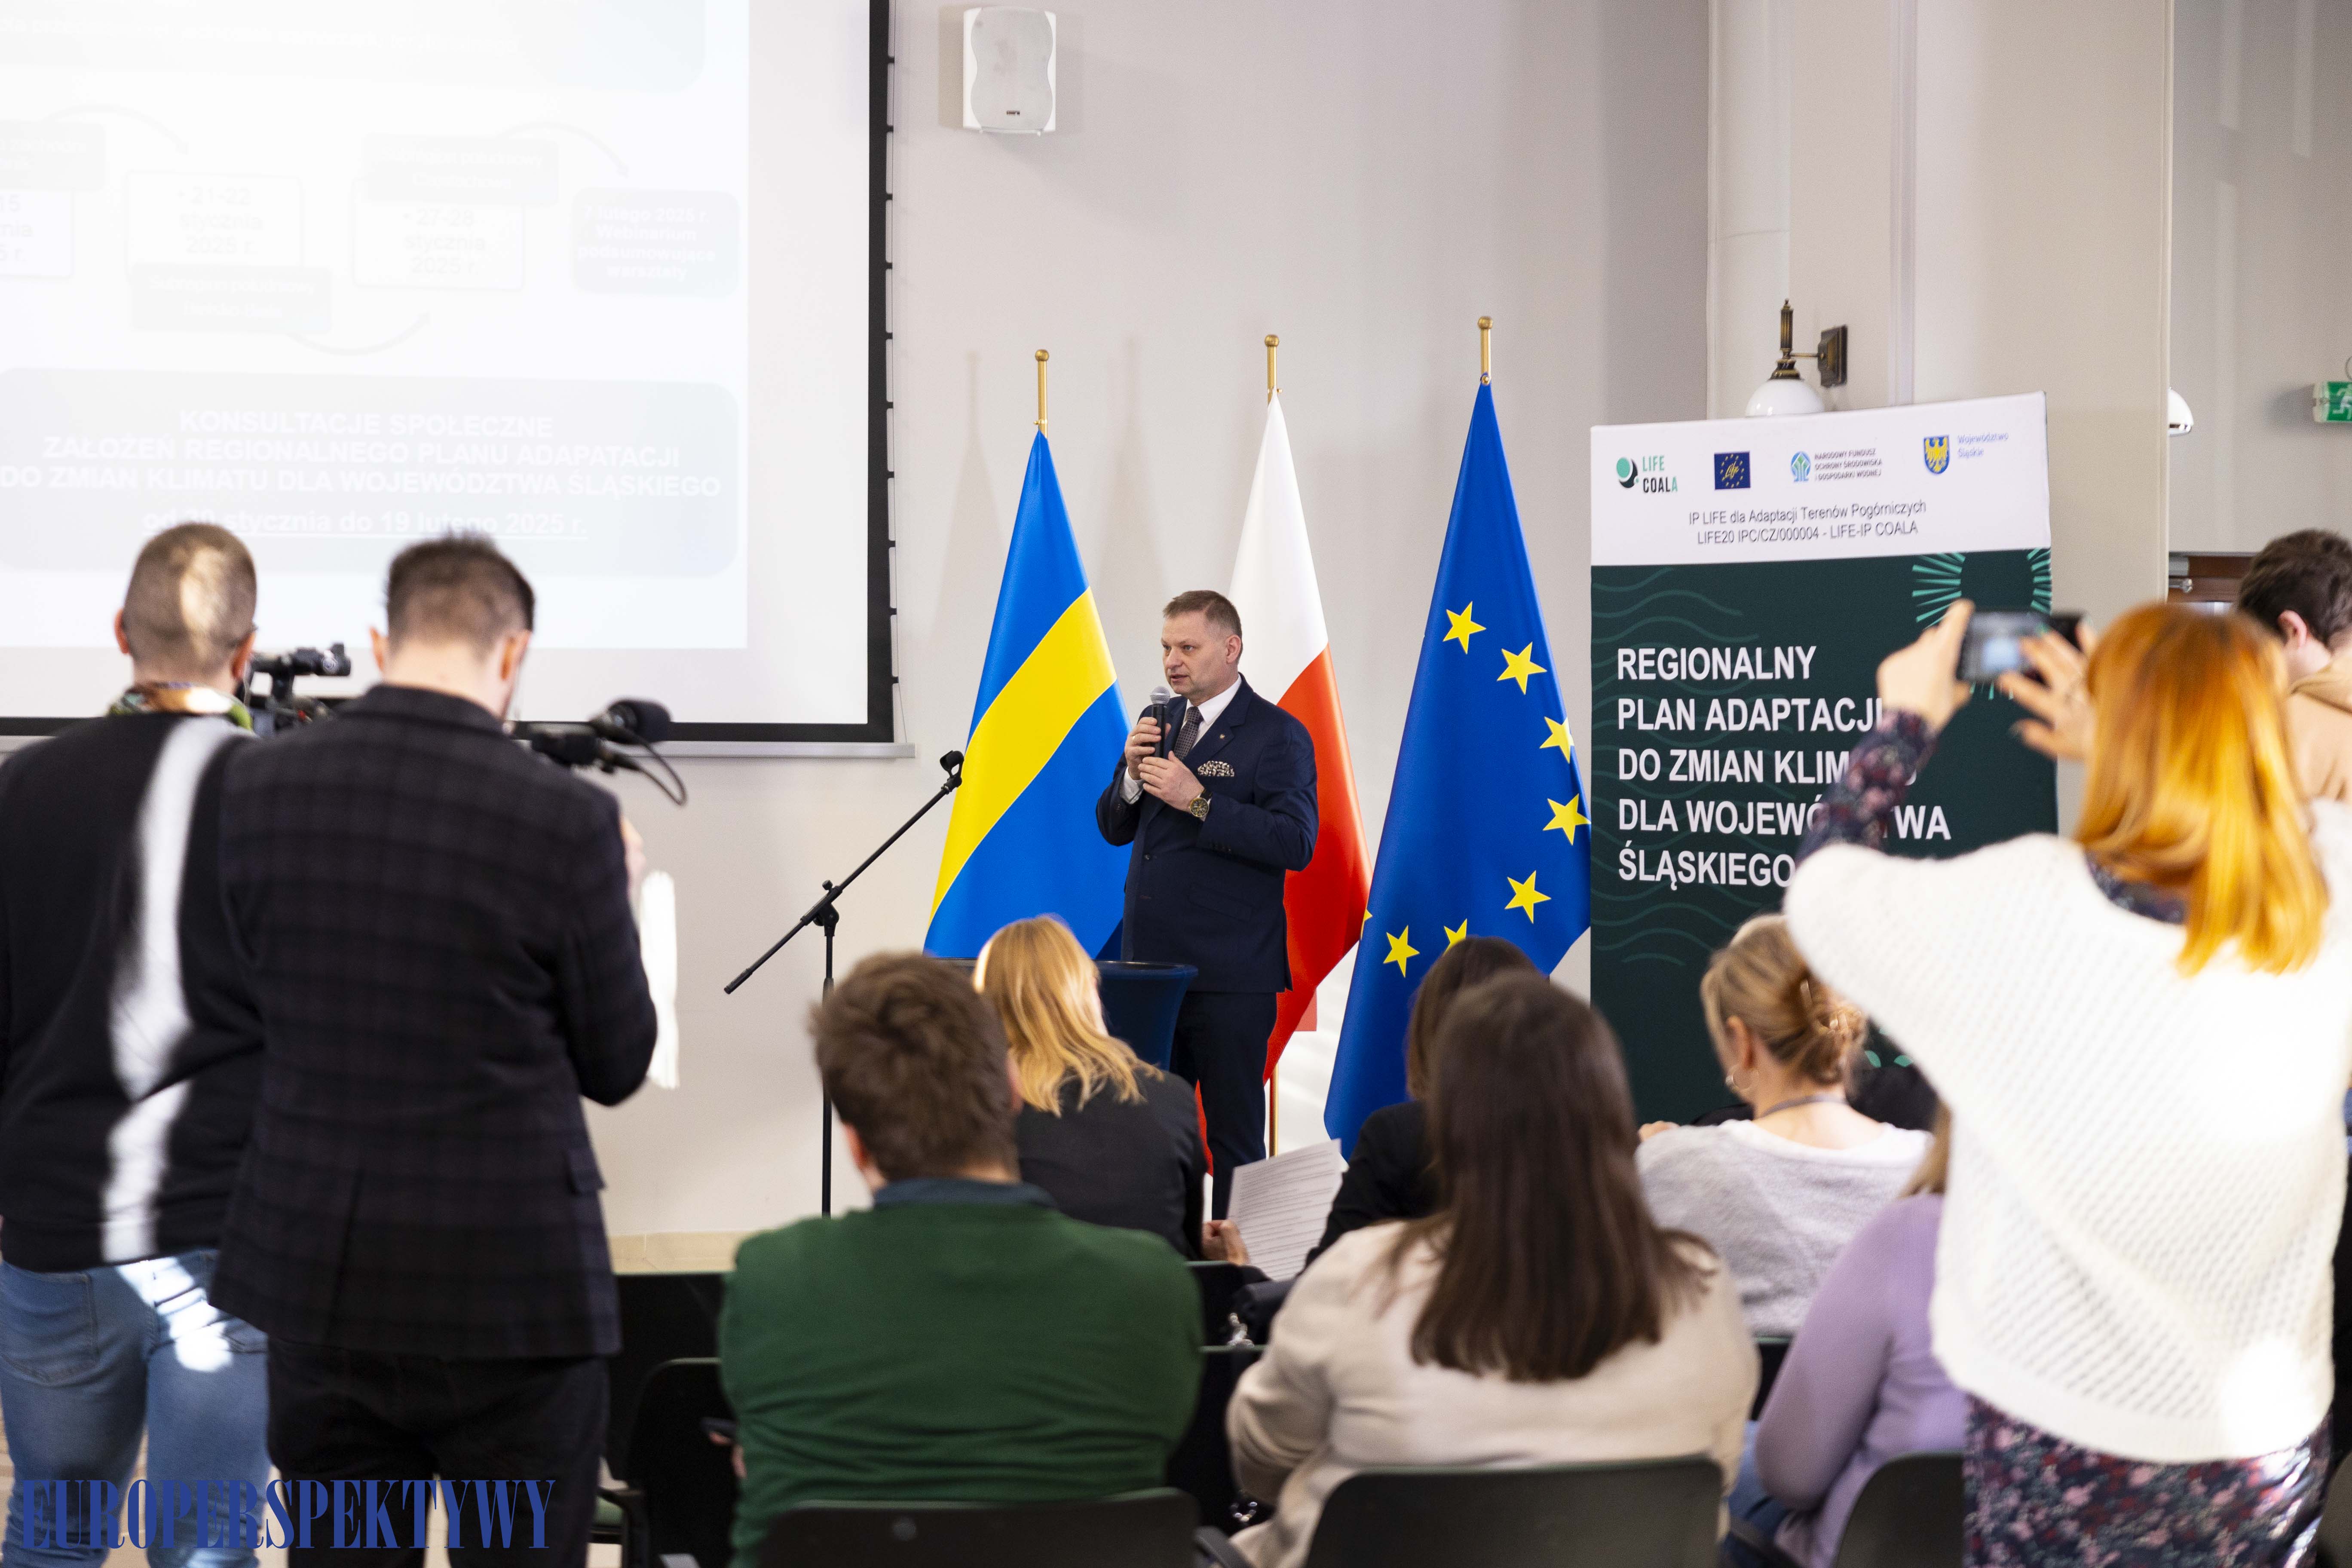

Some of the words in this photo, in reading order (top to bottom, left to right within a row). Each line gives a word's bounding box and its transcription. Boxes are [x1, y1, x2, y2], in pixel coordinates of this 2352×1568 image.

[180, 410, 380, 435] KONSULTACJE
[390, 414, 553, 438] SPOŁECZNE
[43, 432, 171, 459] ZAŁOŻEŃ
[185, 439, 409, 463] REGIONALNEGO
[418, 443, 508, 464] PLANU
[517, 444, 680, 467] ADAPATACJI
[1958, 432, 2009, 444] Województwo
[1642, 455, 1665, 472] LIFE
[1815, 451, 1847, 460] NARODOWY
[1849, 448, 1876, 456] FUNDUSZ
[1815, 462, 1842, 470] OCHRONY
[1844, 459, 1883, 468] ŚRODOWISKA
[0, 466, 42, 488] DO
[48, 467, 138, 489] ZMIAN
[147, 469, 267, 490] KLIMATU
[277, 469, 333, 491] DLA
[341, 468, 560, 495] WOJEWÓDZTWA
[567, 469, 721, 500] ŚLĄSKIEGO
[1643, 477, 1678, 493] COALA
[1819, 472, 1855, 481] GOSPODARKI
[224, 510, 330, 535] stycznia
[339, 511, 372, 532] do
[380, 511, 410, 533] 19
[505, 512, 564, 534] 2025
[572, 518, 588, 535] r.
[1689, 511, 1700, 525] IP
[1703, 511, 1727, 525] LIFE
[1730, 510, 1745, 523] dla
[1749, 507, 1798, 524] Adaptacji
[1801, 505, 1848, 520] Terenów
[1852, 499, 1926, 519] Pogórniczych
[1698, 530, 1734, 544] LIFE20
[1738, 526, 1819, 542] IPC/CZ/000004
[1830, 523, 1872, 539] LIFE-IP
[1875, 521, 1919, 536] COALA
[1617, 646, 1816, 680] REGIONALNY
[1618, 698, 1695, 731] PLAN
[1705, 697, 1883, 732] ADAPTACJI
[1619, 749, 1661, 781] DO
[1669, 749, 1763, 783] ZMIAN
[1619, 799, 1678, 832] DLA
[1619, 840, 1796, 890] ŚLĄSKIEGO
